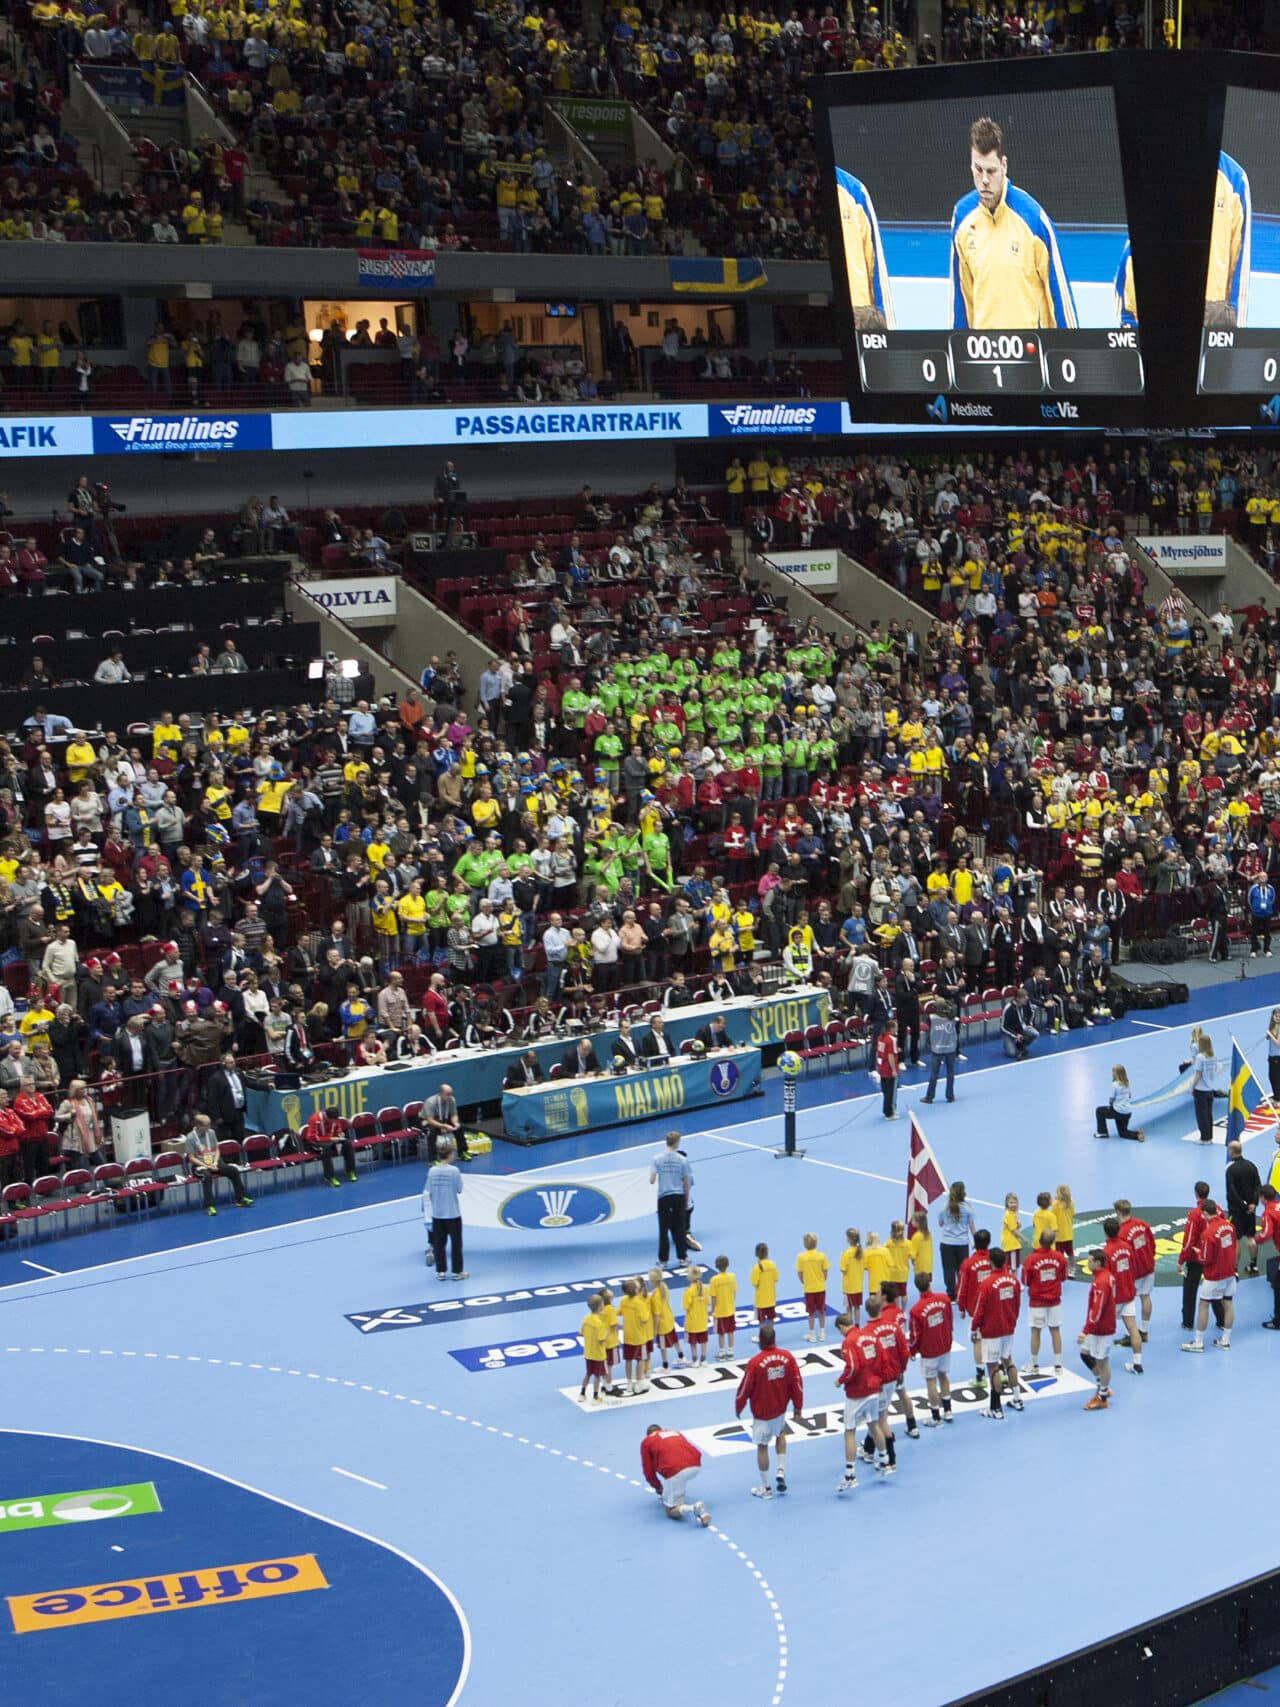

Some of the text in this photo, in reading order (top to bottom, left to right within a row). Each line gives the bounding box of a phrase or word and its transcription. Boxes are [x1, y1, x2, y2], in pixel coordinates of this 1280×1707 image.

[862, 334, 887, 349] DEN
[966, 335, 1024, 359] 00:00
[1107, 332, 1137, 348] SWE
[1208, 332, 1234, 347] DEN
[922, 359, 936, 382] 0
[992, 365, 1003, 388] 1
[1061, 359, 1076, 383] 0
[1263, 358, 1277, 382] 0
[733, 405, 816, 425] Finnlines
[951, 403, 993, 417] Mediatec
[1040, 402, 1079, 418] tecViz
[125, 418, 239, 441] Finnlines
[456, 412, 682, 435] PASSAGERARTRAFIK
[1160, 545, 1224, 560] Myresjöhus
[810, 563, 832, 571] ECO
[751, 998, 809, 1044] SPORT
[614, 1069, 685, 1119] MALMÖ
[31, 1563, 299, 1616] office
